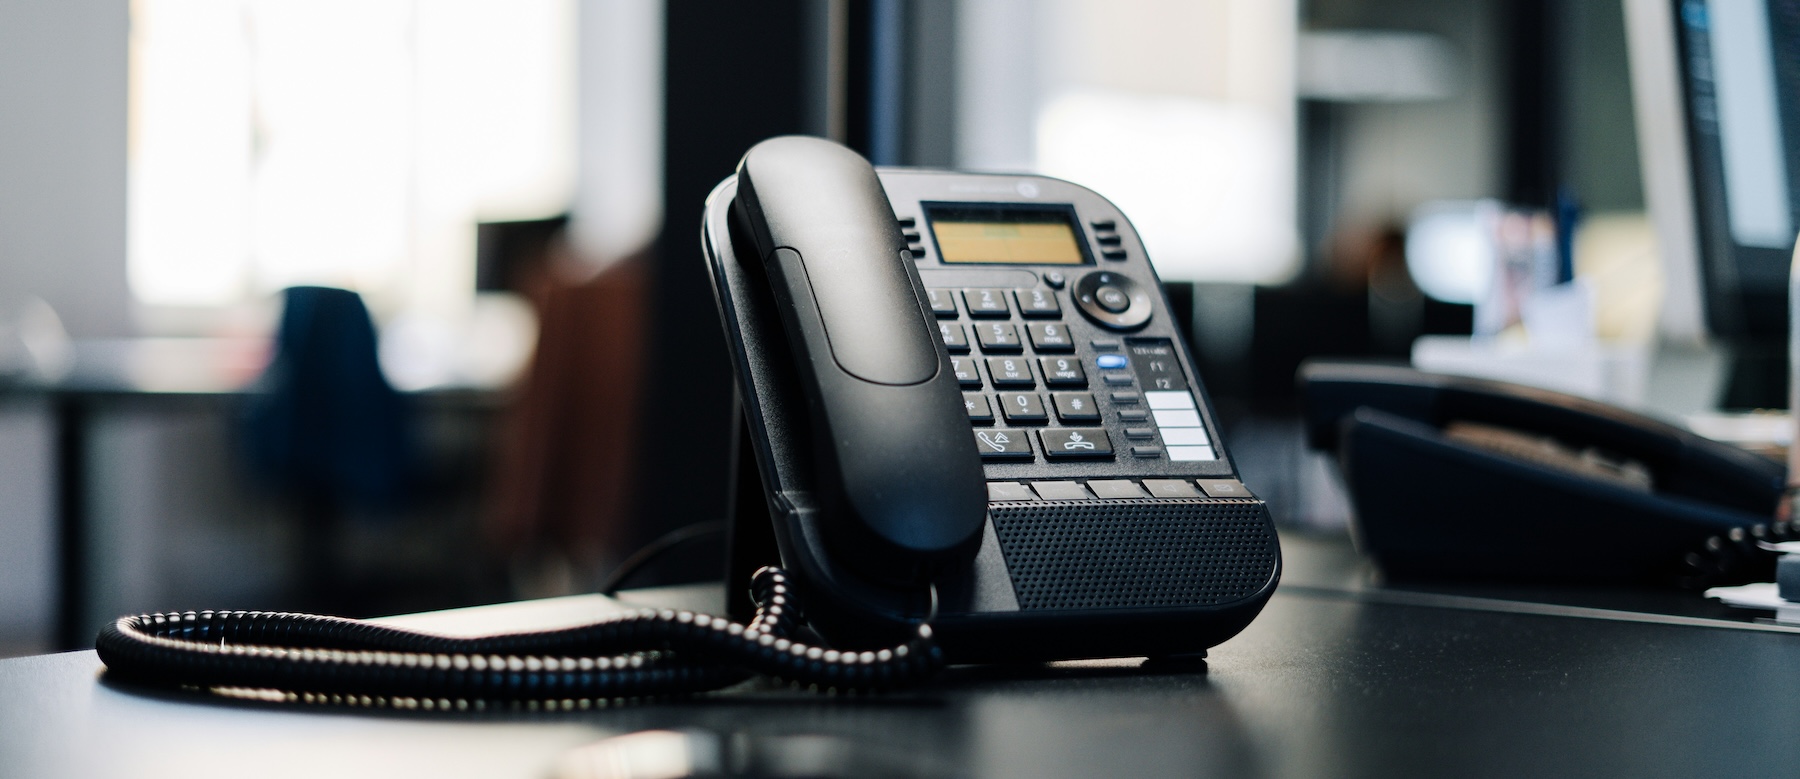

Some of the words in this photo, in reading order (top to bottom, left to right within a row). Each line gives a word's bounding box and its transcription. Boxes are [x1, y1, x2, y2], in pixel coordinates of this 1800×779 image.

[929, 291, 937, 301] 1
[981, 290, 992, 302] 2
[1032, 291, 1043, 302] 3
[1104, 293, 1121, 303] OK
[940, 325, 949, 335] 4
[993, 325, 1002, 335] 5
[1045, 325, 1056, 336] 6
[951, 360, 959, 371] 7
[1004, 360, 1014, 371] 8
[1057, 360, 1067, 371] 9
[1150, 361, 1163, 372] F1
[1155, 379, 1170, 389] F2
[1017, 395, 1027, 407] 0
[1071, 398, 1082, 410] #
